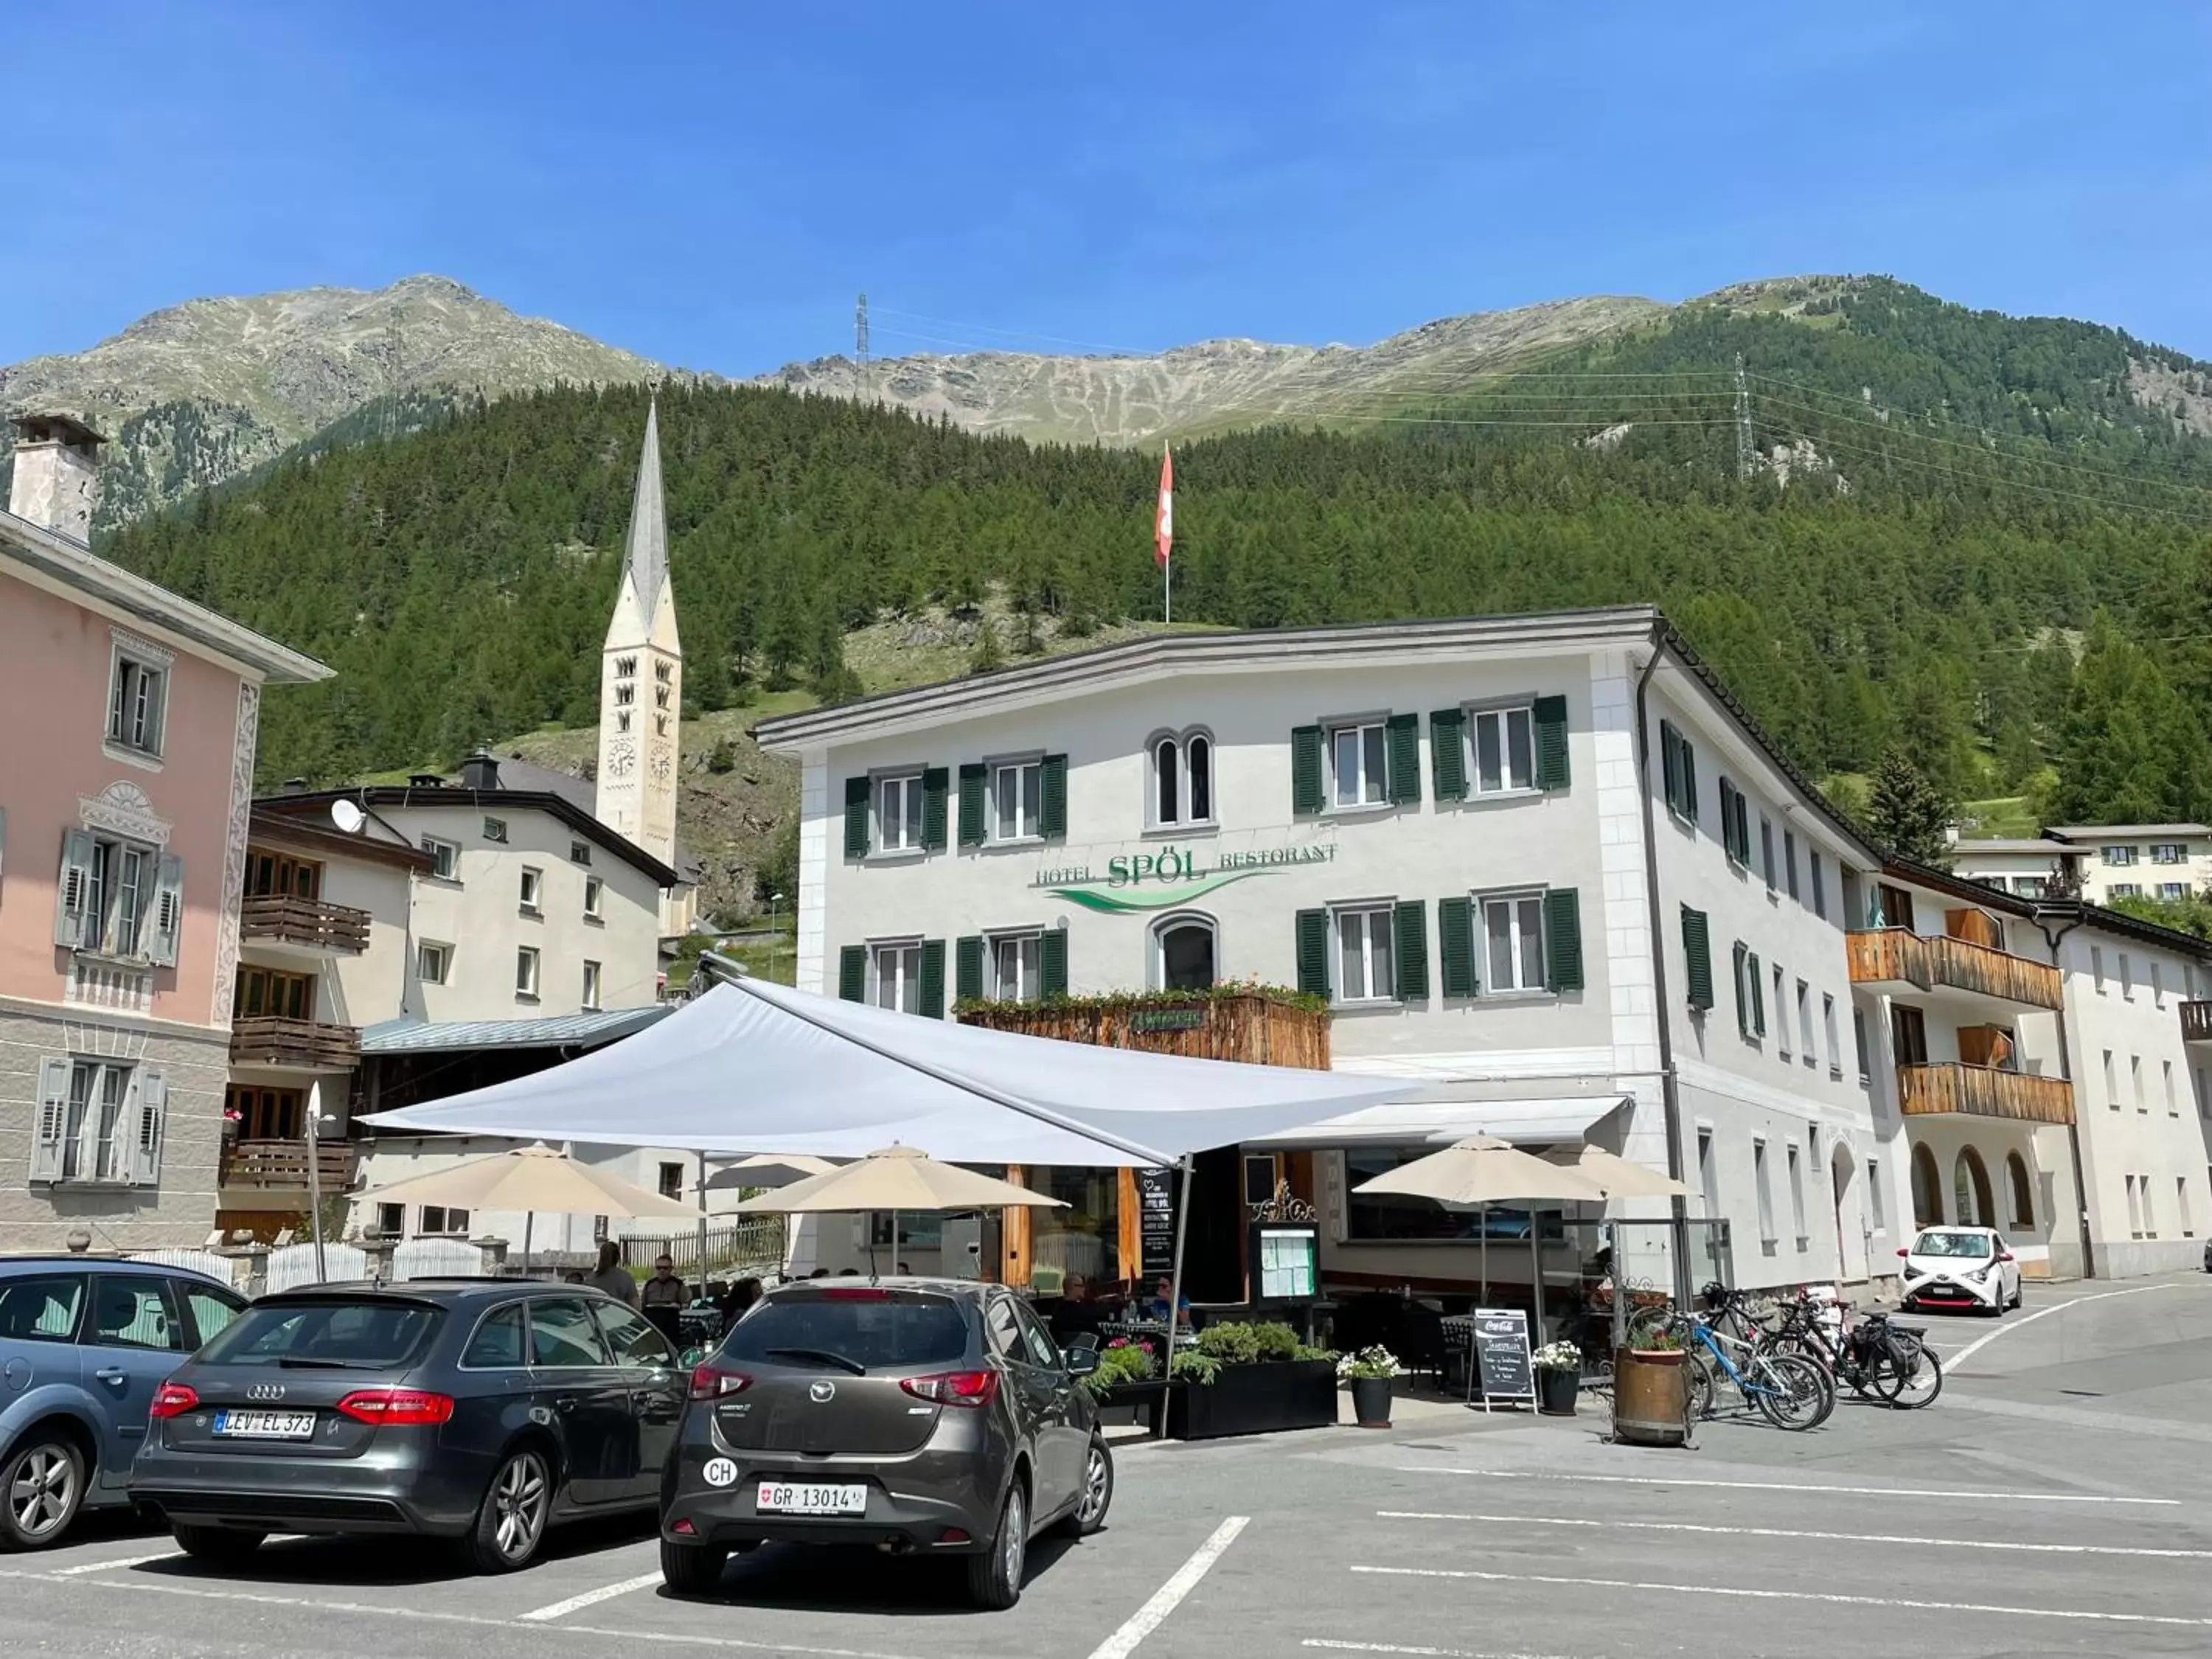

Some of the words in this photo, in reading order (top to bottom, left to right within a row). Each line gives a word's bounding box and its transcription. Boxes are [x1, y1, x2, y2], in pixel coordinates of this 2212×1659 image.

[1036, 866, 1096, 885] HOTEL
[1107, 846, 1207, 888] SPÖL
[1220, 844, 1338, 869] RESTORANT
[225, 1411, 254, 1430] LEV
[262, 1413, 279, 1431] EL
[284, 1414, 313, 1433] 373
[710, 1462, 731, 1481] CH
[773, 1486, 793, 1506] GR
[803, 1488, 849, 1508] 13014
